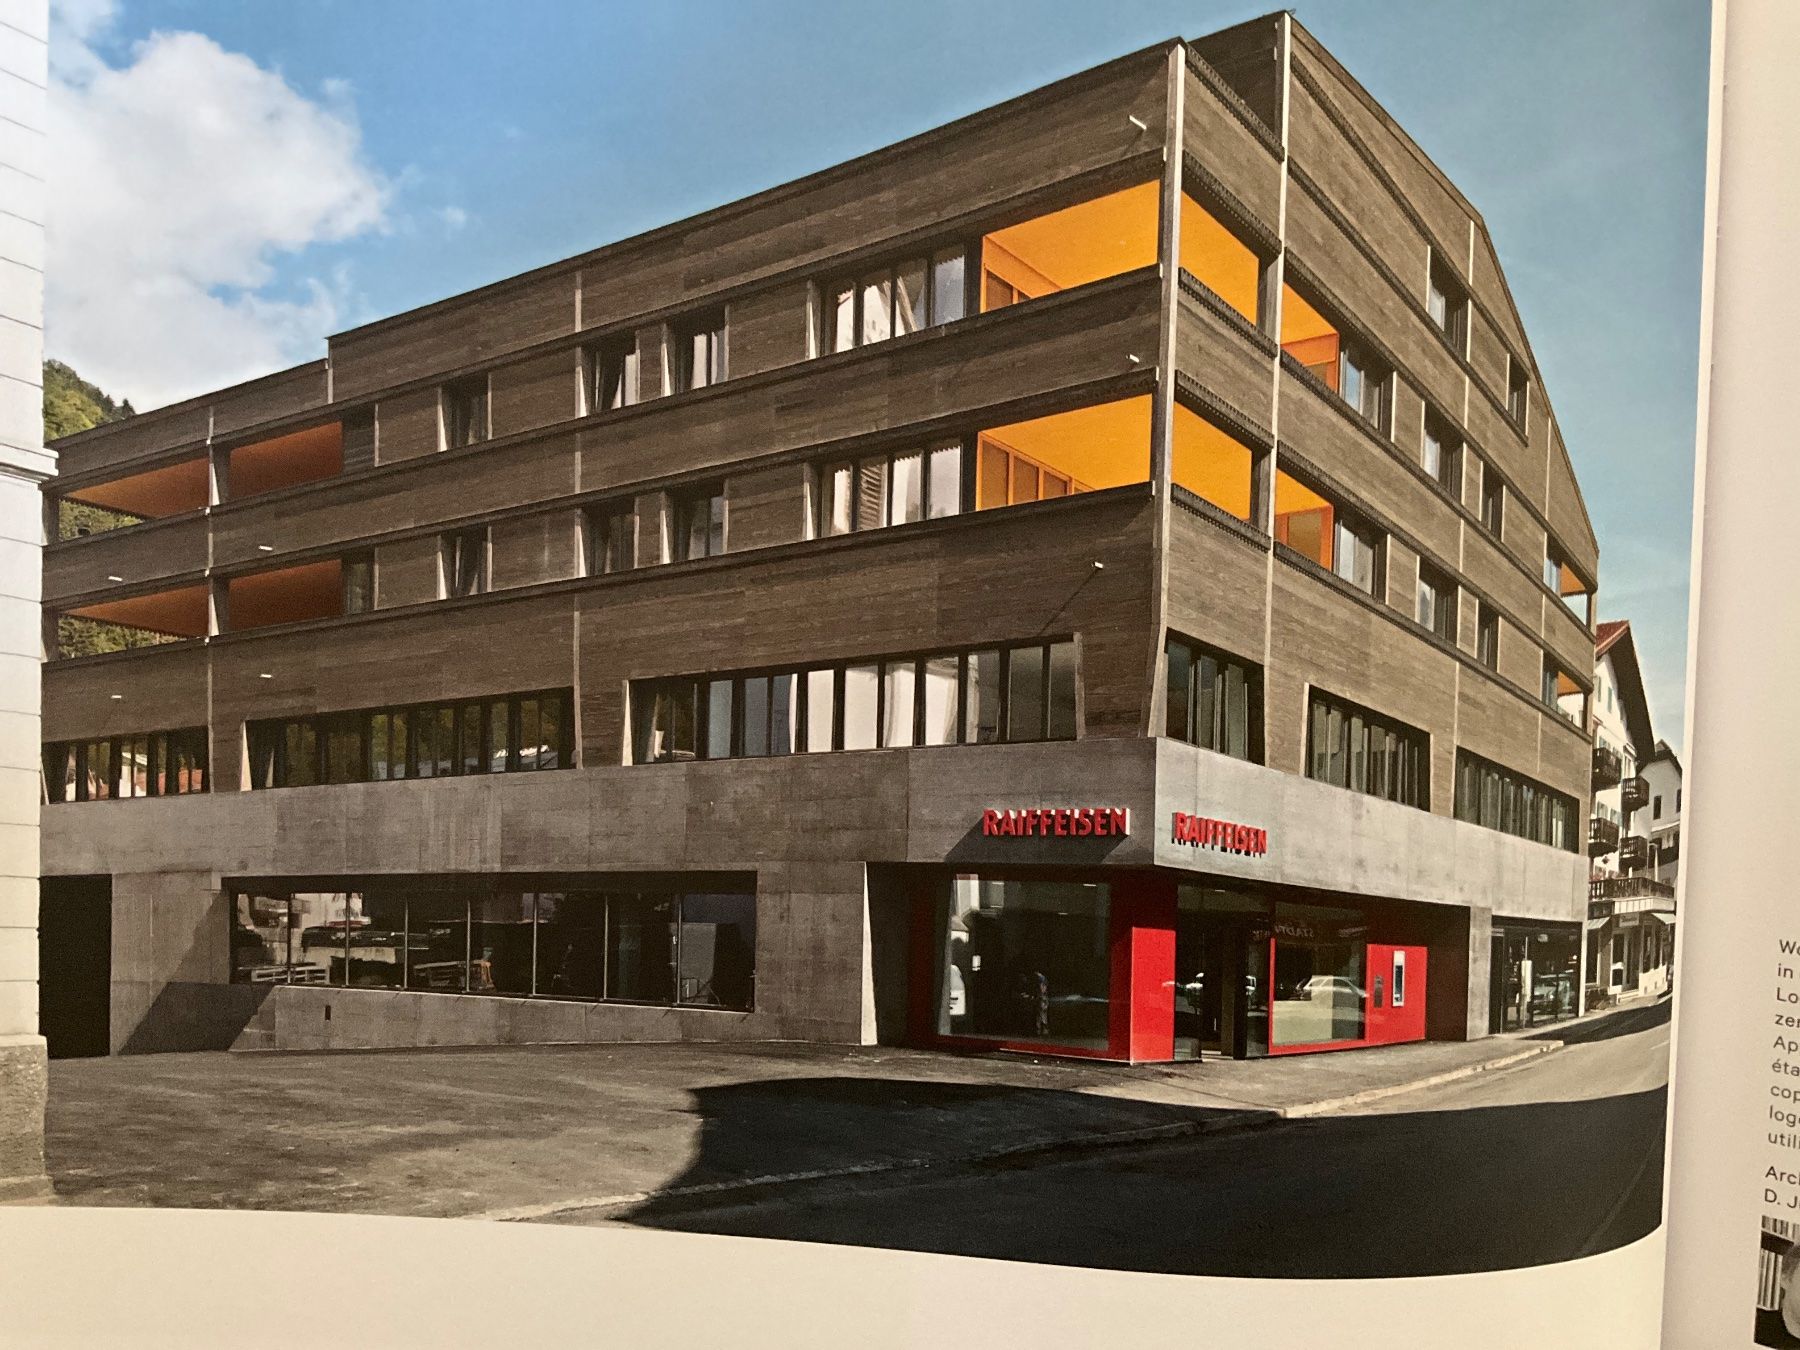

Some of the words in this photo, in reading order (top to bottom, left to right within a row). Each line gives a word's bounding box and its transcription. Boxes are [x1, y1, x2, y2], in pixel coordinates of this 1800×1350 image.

[982, 807, 1131, 836] RAIFFEISEN
[1172, 812, 1267, 855] RAIFFEISEN
[1764, 1188, 1781, 1205] D.
